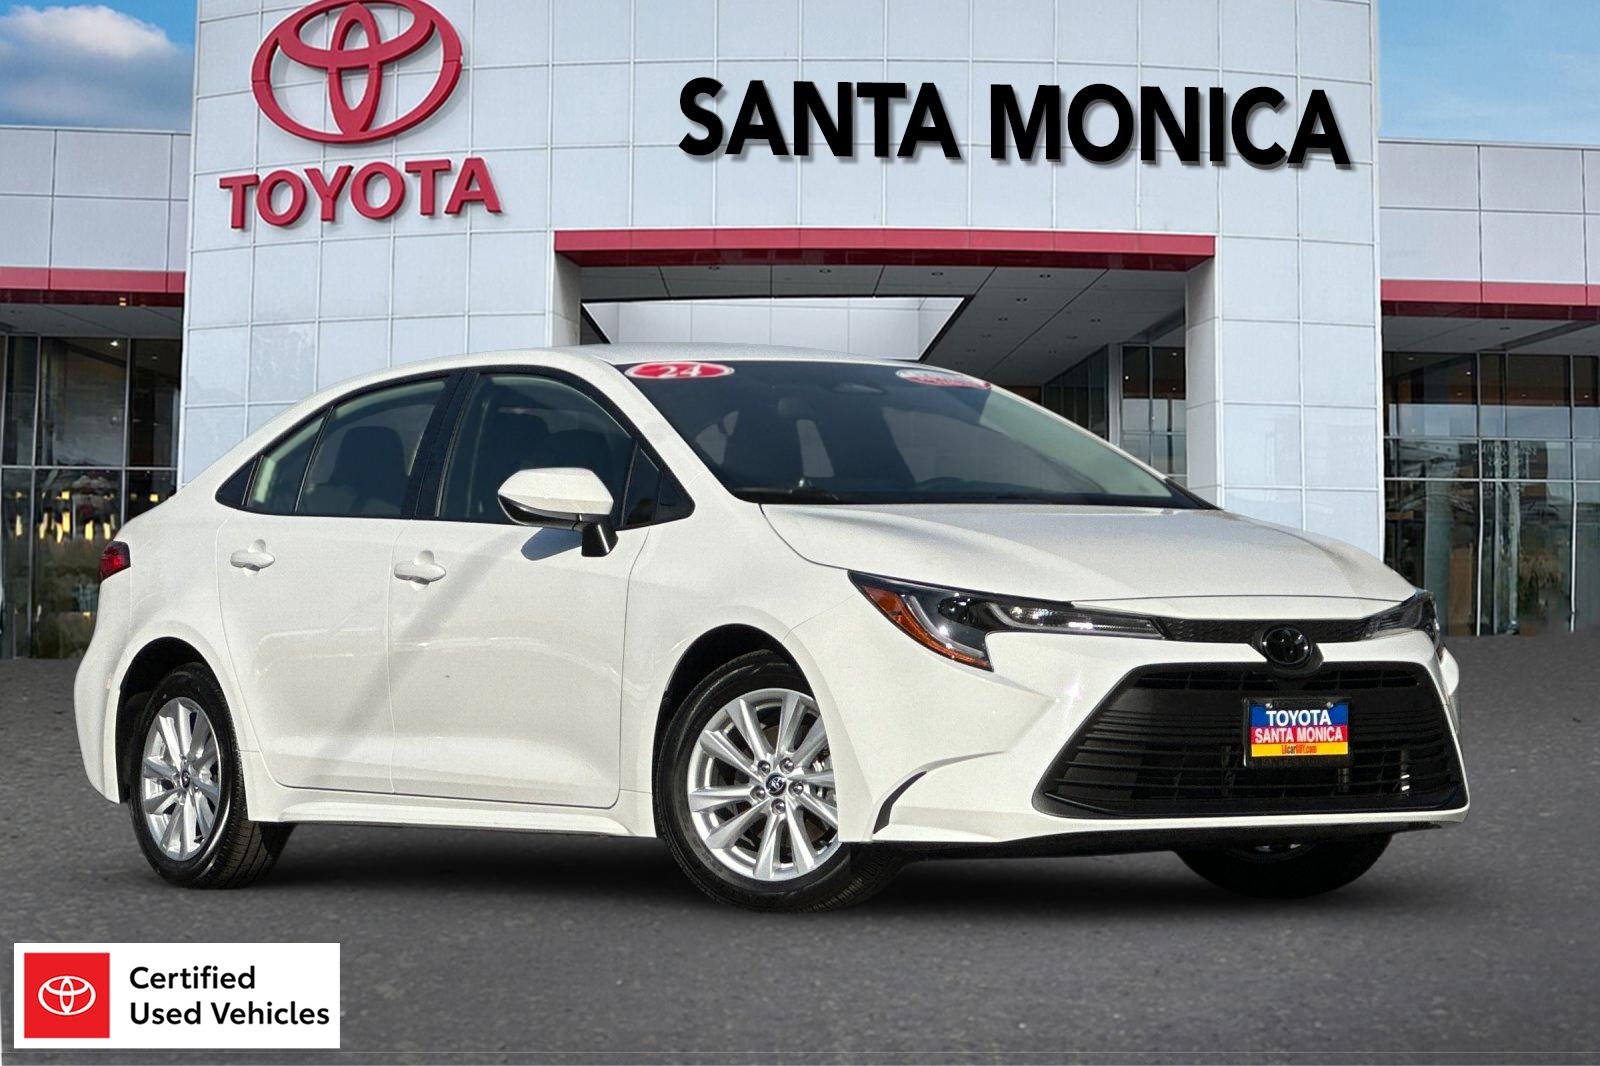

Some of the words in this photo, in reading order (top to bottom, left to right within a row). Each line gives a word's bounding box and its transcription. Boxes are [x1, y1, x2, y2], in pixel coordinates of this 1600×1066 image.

[679, 78, 961, 160] SANTA
[990, 83, 1352, 169] MONICA
[219, 157, 501, 229] TOYOTA
[658, 364, 702, 378] 24
[1265, 709, 1332, 727] TOYOTA
[1254, 727, 1294, 744] SANTA
[1296, 726, 1343, 742] MONICA
